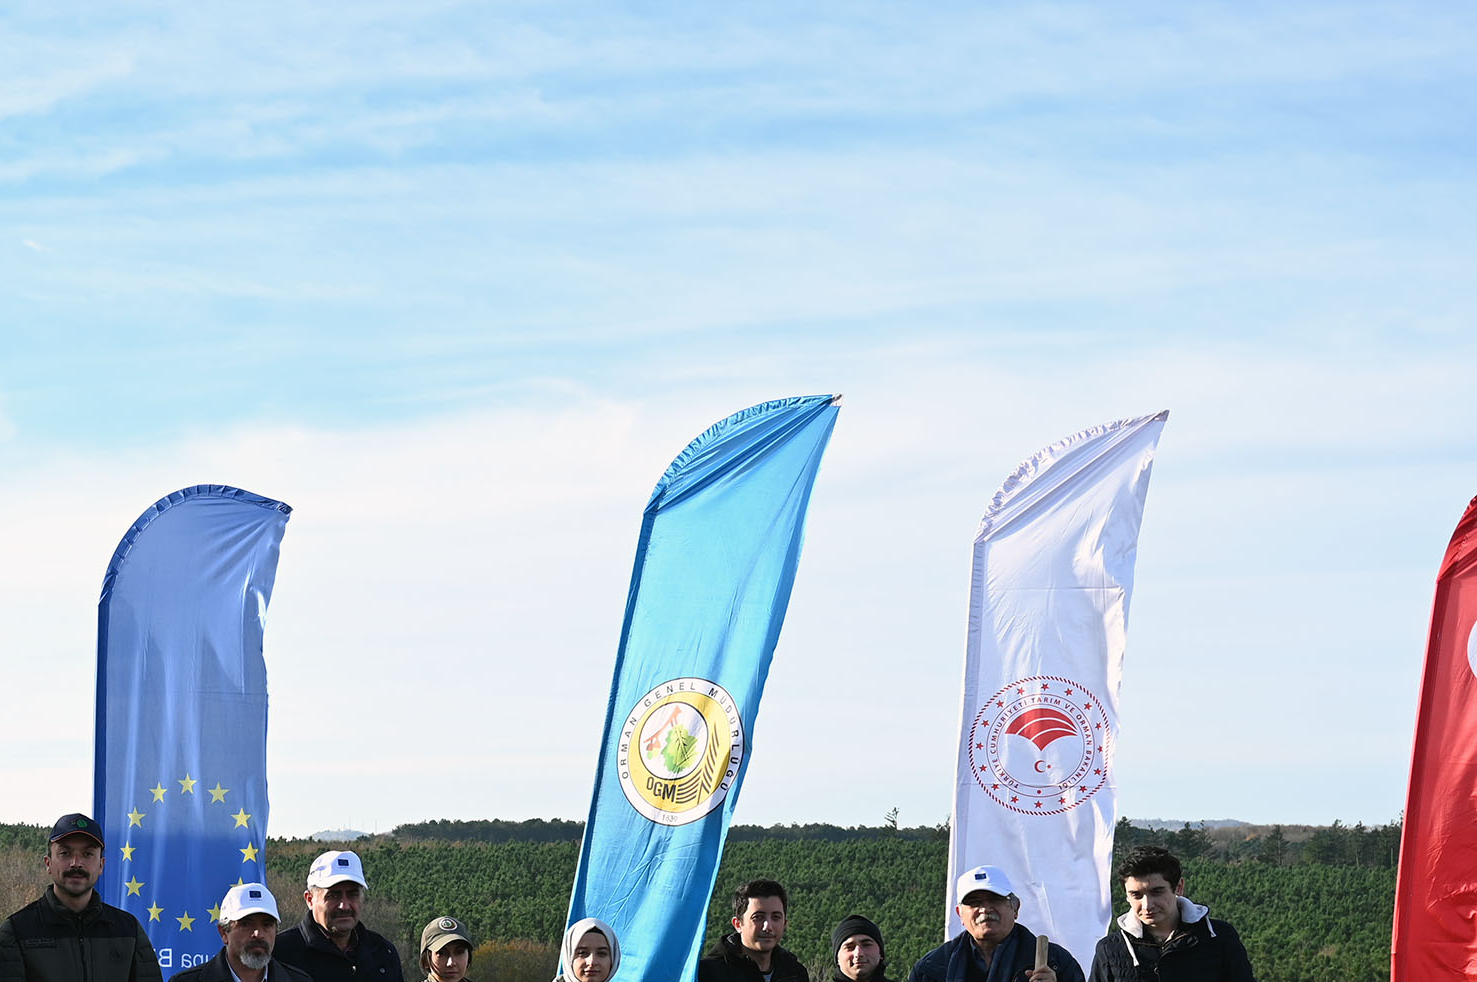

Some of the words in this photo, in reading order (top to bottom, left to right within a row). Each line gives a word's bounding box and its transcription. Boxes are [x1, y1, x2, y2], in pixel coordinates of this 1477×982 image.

[620, 717, 637, 779] ORMAN
[644, 682, 696, 708] GENEL
[1031, 696, 1061, 706] TARIM
[1064, 703, 1076, 714] VE
[1076, 714, 1093, 746] ORMAN
[646, 776, 677, 803] OGM
